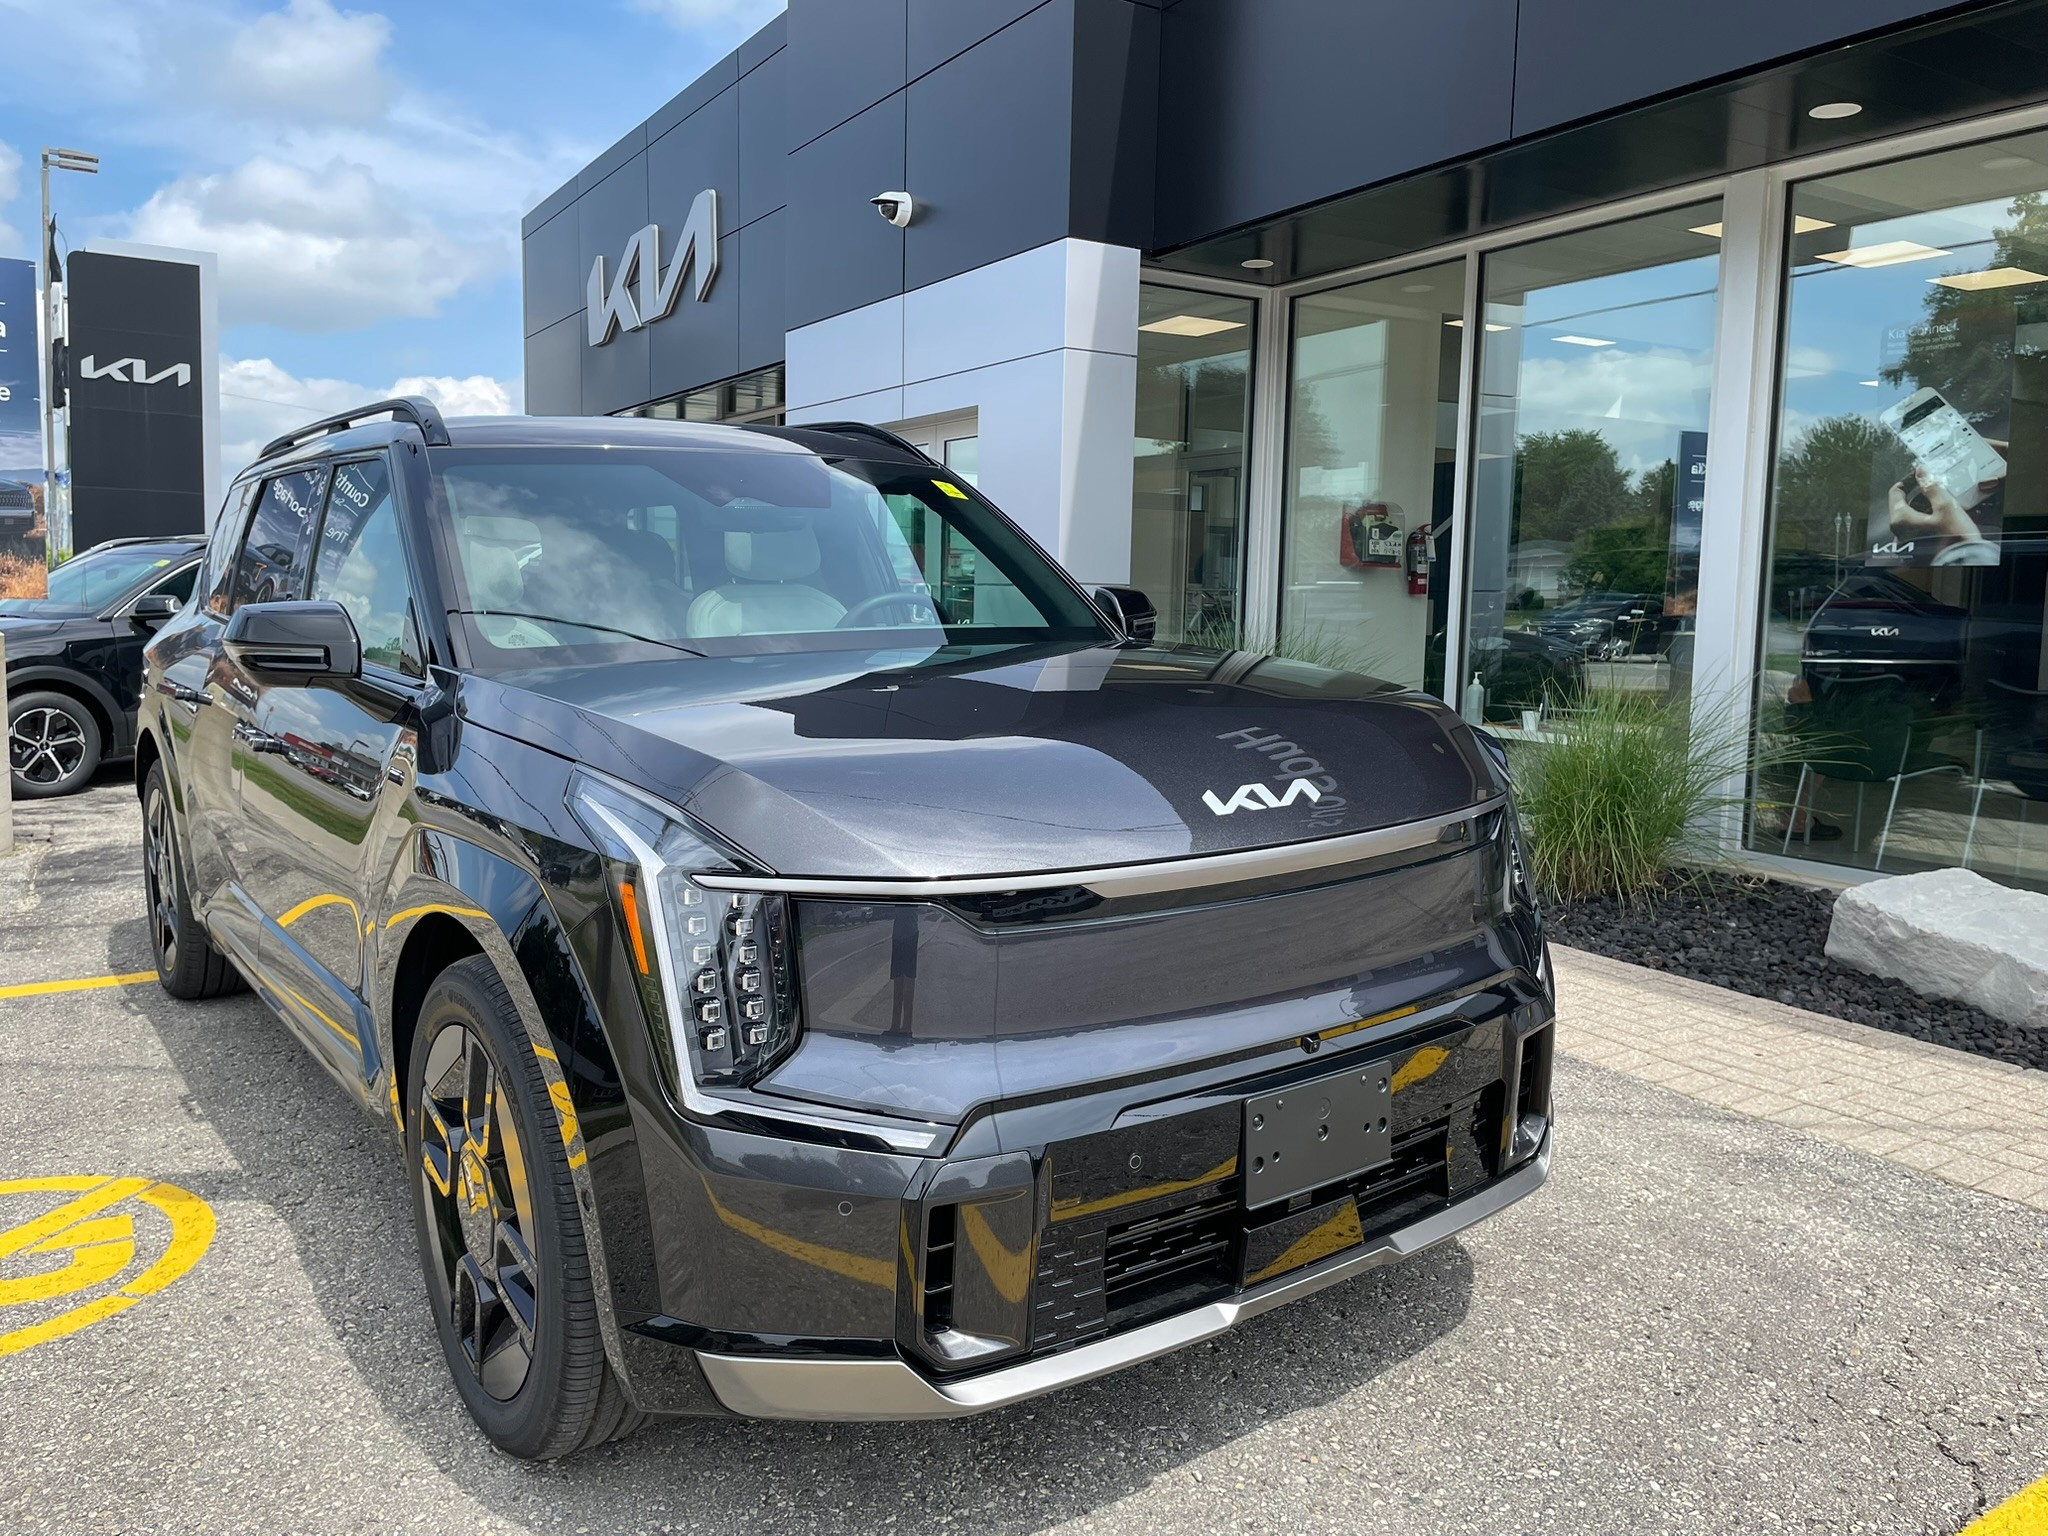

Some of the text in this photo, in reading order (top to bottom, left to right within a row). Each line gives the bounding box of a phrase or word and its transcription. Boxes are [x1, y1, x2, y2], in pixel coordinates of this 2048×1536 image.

[587, 188, 718, 346] KIA
[81, 354, 191, 387] KIA
[1872, 542, 1915, 553] KIA
[1870, 627, 1900, 637] KIA
[1201, 778, 1321, 816] KIA
